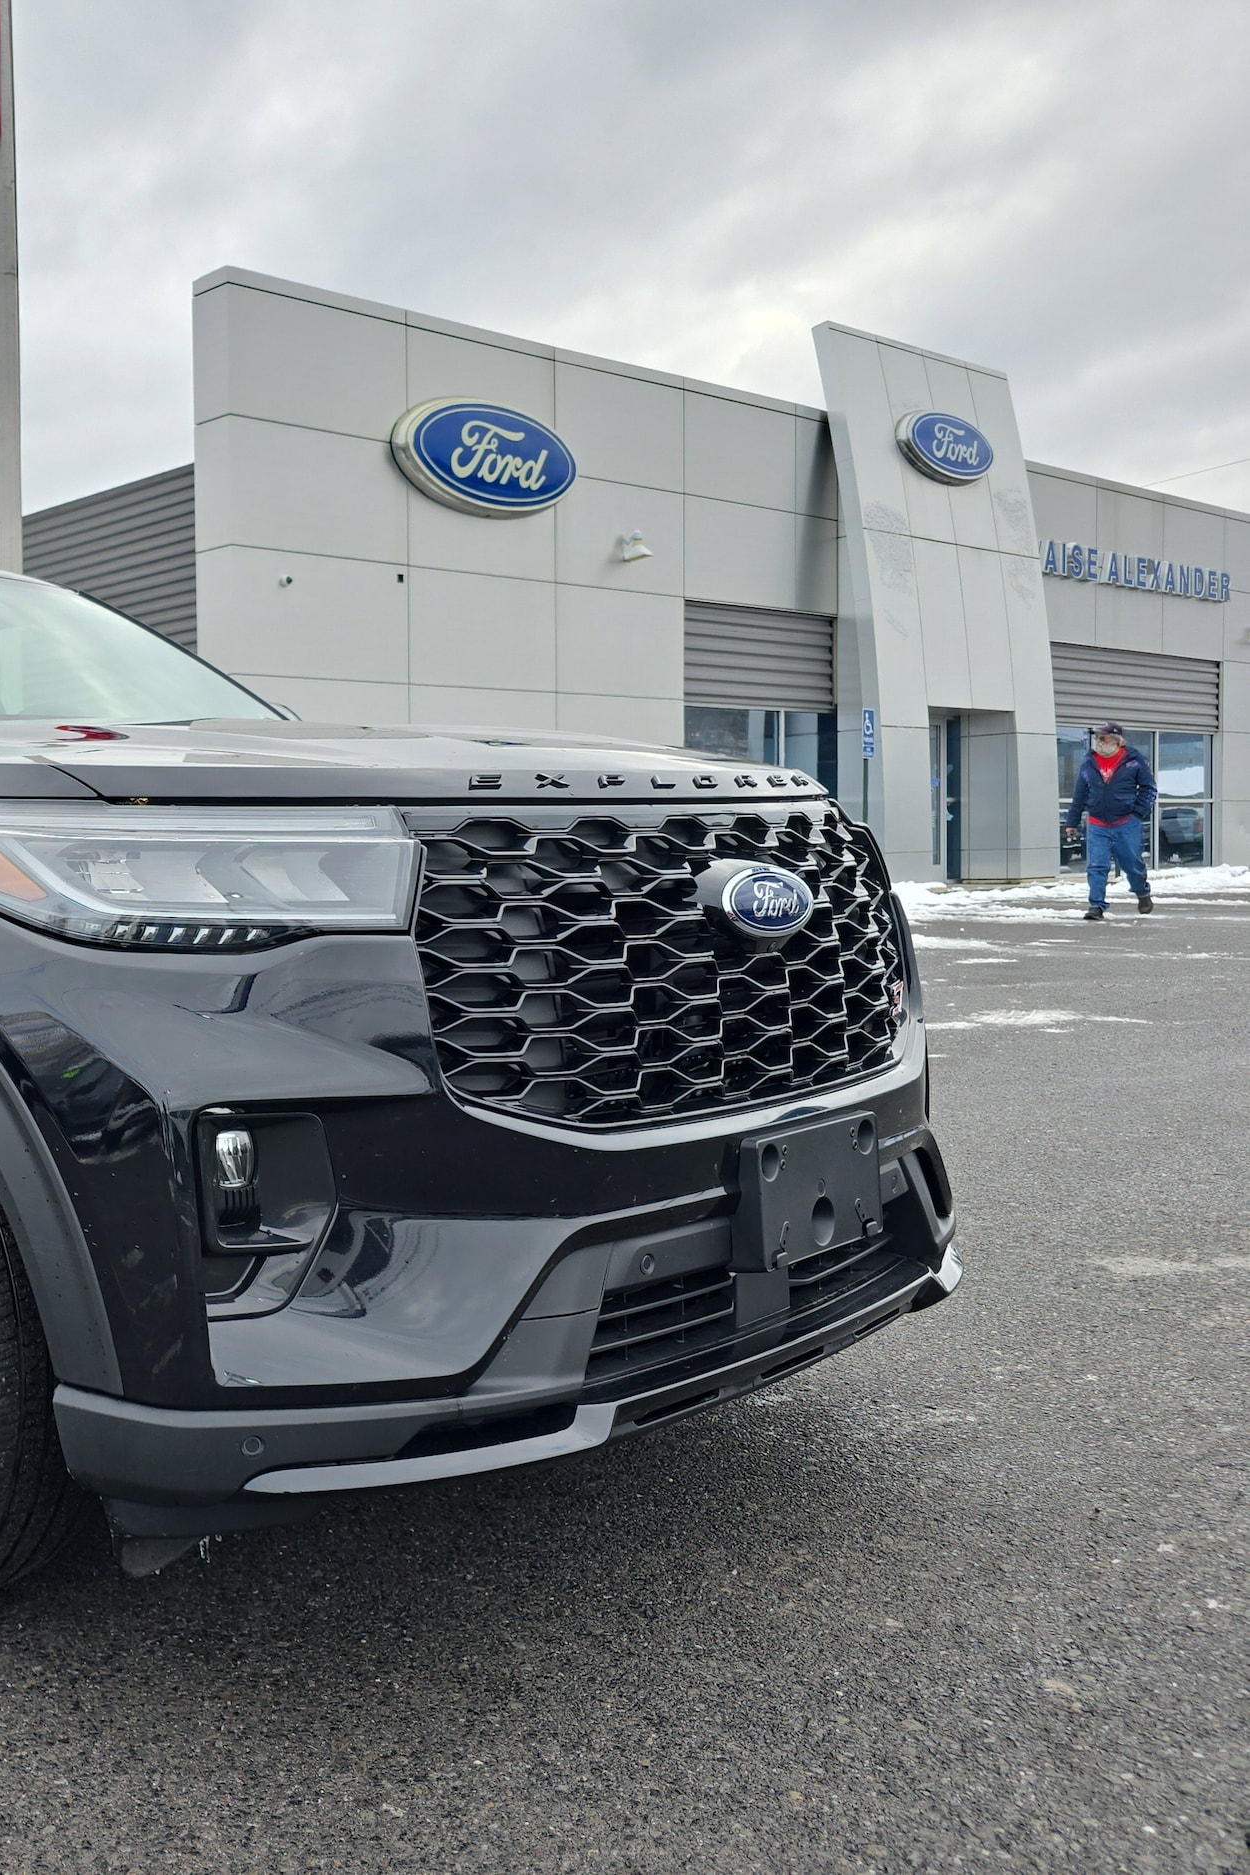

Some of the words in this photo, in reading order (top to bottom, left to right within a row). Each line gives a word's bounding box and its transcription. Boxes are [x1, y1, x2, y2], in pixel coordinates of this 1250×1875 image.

[451, 420, 548, 491] Ford
[932, 423, 980, 466] Ford
[1107, 552, 1231, 601] ALEXANDER
[468, 773, 809, 790] EXPLORER
[752, 881, 800, 919] Ford
